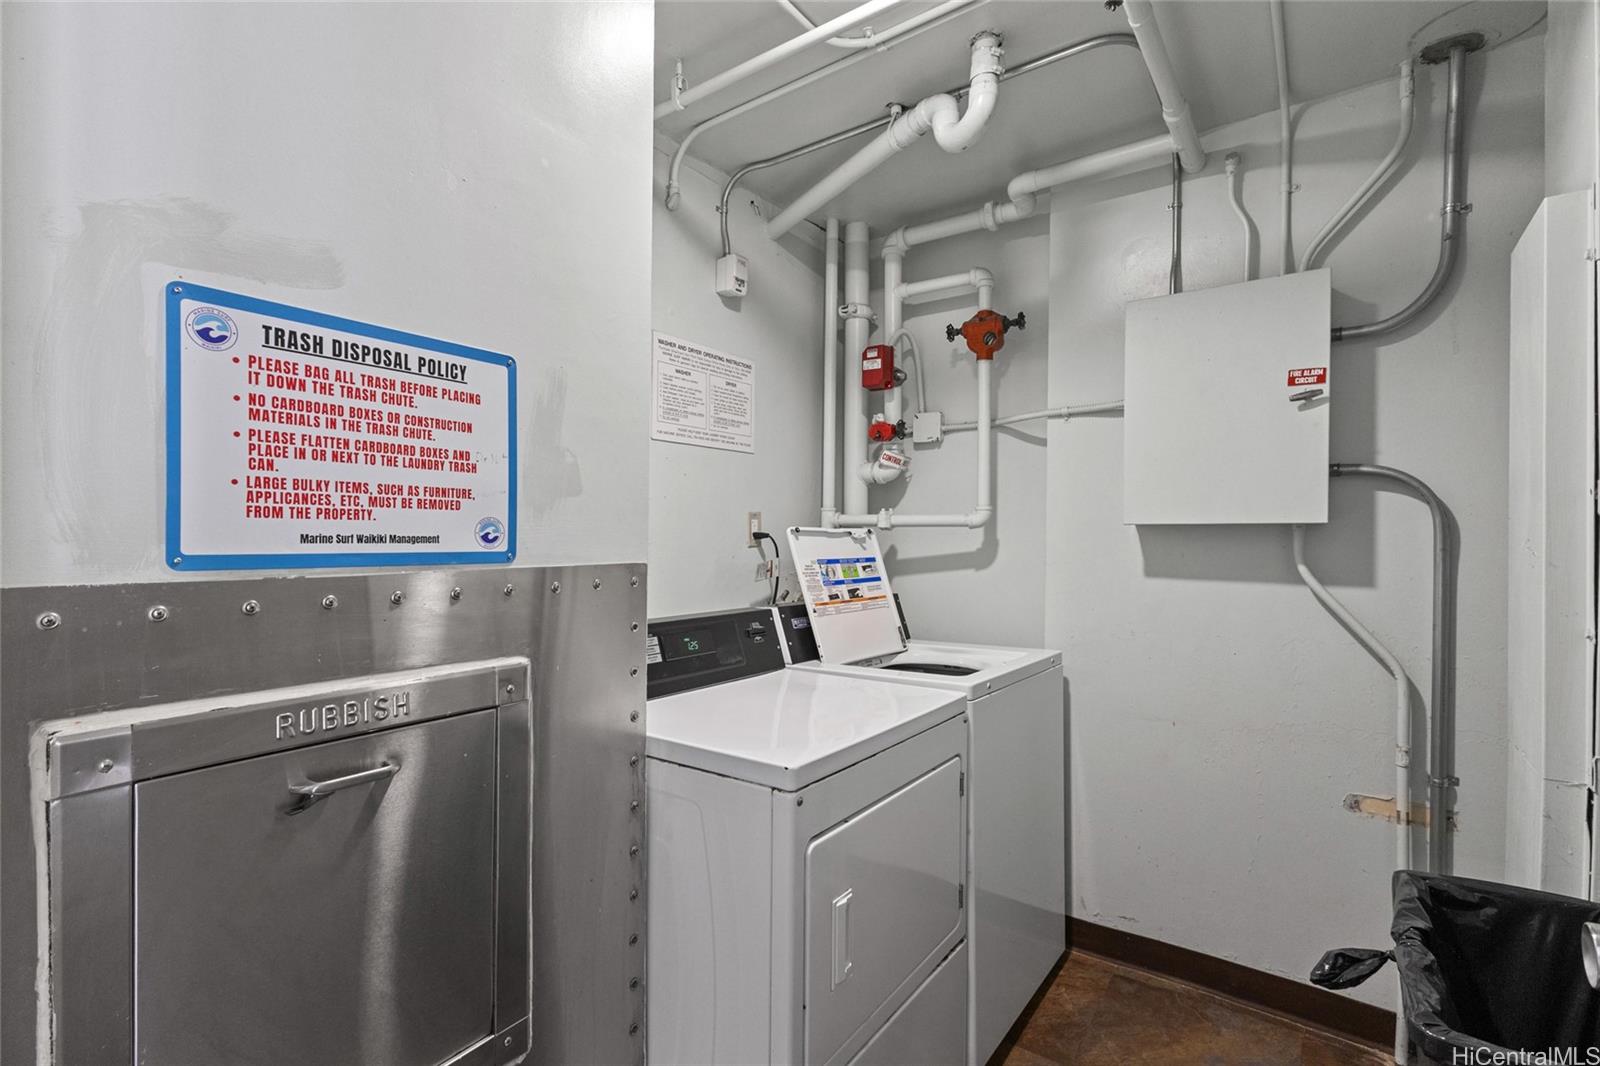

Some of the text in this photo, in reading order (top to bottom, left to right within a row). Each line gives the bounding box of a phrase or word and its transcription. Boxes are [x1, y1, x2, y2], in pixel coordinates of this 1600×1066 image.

[262, 324, 467, 382] TRASH DISPOSAL POLICY
[657, 339, 676, 348] WASHER
[678, 344, 688, 352] AND
[688, 347, 702, 356] DRYER
[703, 352, 724, 362] OPERATING
[726, 358, 752, 369] INSTRUCTIONS
[248, 355, 481, 405] PLEASE BAG ALL TRASH BEFORE PLACING
[248, 371, 418, 408] IT DOWN THE TRASH CHUTE.
[1295, 376, 1317, 384] CIRCUIT
[248, 393, 473, 434] NO CARDBOARD BOXES OR CONSTRUCTION
[248, 408, 436, 442] MATERIALS IN THE TRASH CHUTE.
[248, 428, 296, 445] PLEASE
[301, 434, 350, 450] FLATTEN
[354, 440, 416, 457] CARDBOARD
[420, 446, 450, 460] BOXES
[452, 450, 471, 462] AND
[248, 443, 477, 474] PLACE IN OR NEXT TO THE LAUNDRY TRASH
[248, 457, 279, 472] CAN.
[246, 475, 287, 490] LARGE
[292, 478, 330, 492] BULKY
[376, 484, 404, 496] SUCH
[408, 485, 420, 497] AS
[424, 486, 476, 500] FURNITURE,
[246, 505, 376, 520] FROM THE PROPERTY.
[368, 496, 398, 508] MUST
[401, 498, 413, 509] BE
[416, 498, 461, 511] REMOVED
[300, 534, 440, 545] Marine Surf Waikiki Management
[276, 692, 410, 739] RUBBISH
